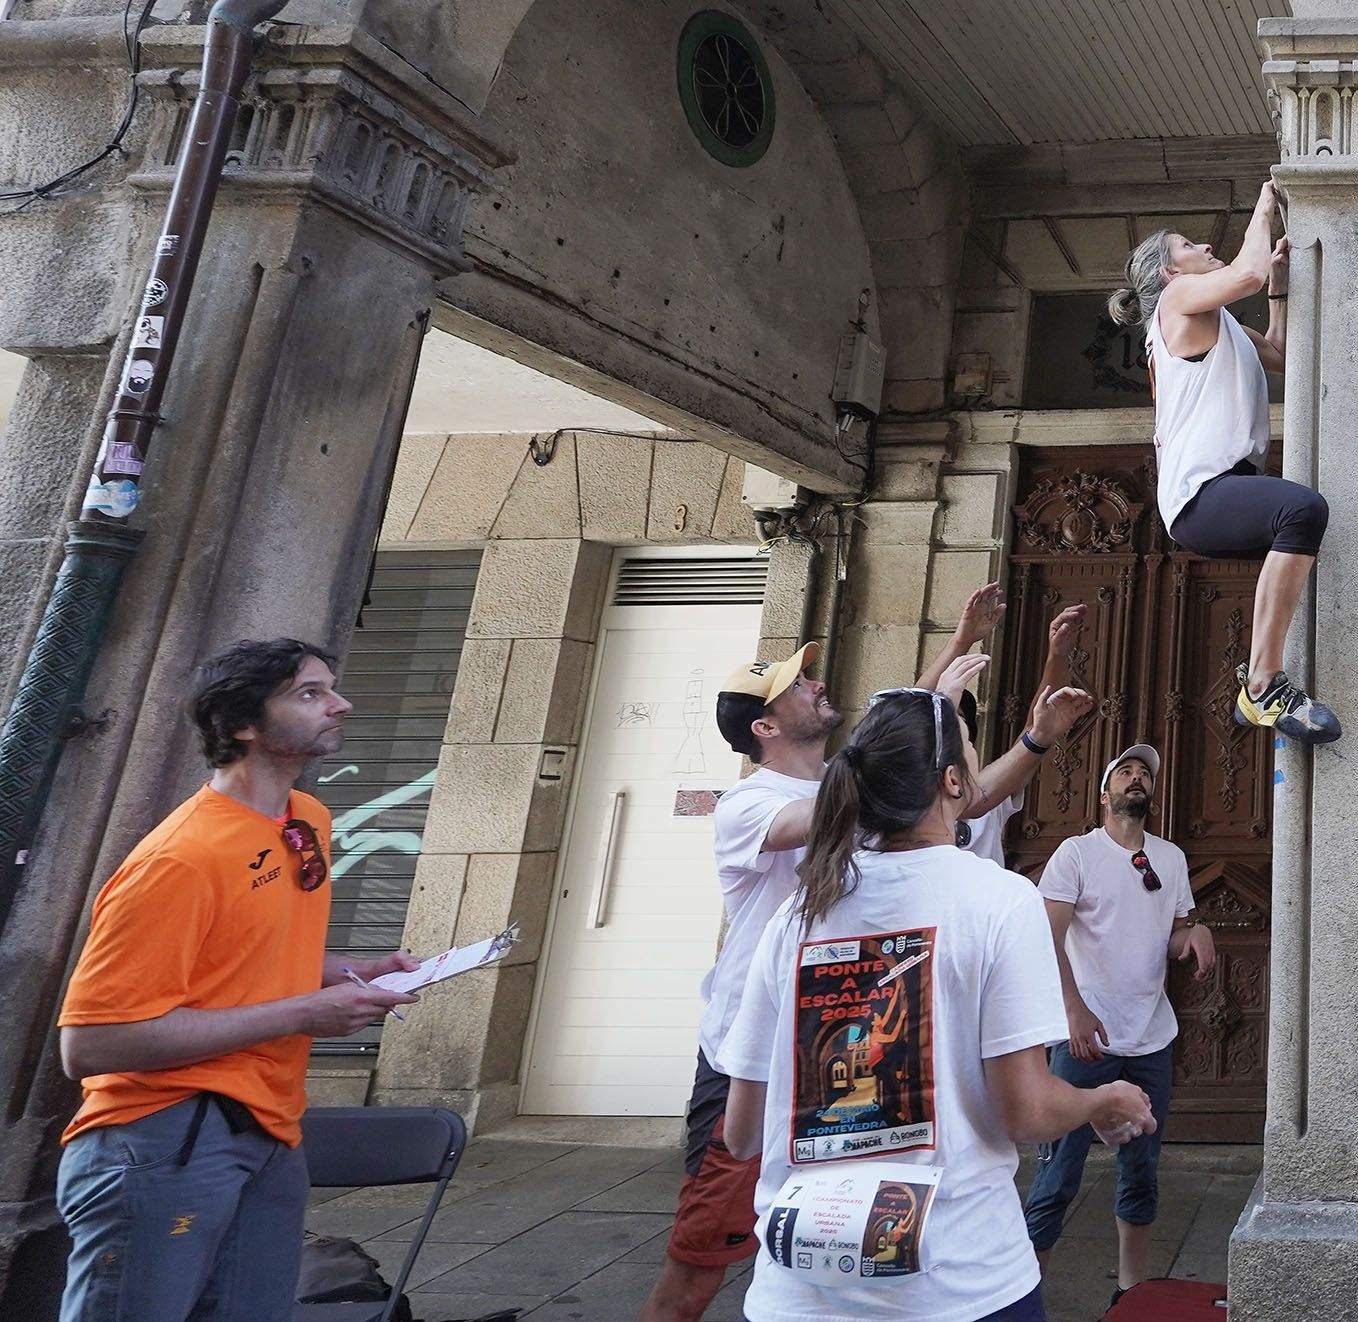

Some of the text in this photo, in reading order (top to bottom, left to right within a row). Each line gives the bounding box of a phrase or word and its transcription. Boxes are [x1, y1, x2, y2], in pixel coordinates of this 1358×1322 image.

[671, 504, 688, 532] 3
[814, 960, 884, 978] PONTE
[840, 978, 857, 990] A
[800, 987, 895, 1008] ESCALAR
[820, 1004, 872, 1021] 2025
[840, 1115, 857, 1124] EN
[806, 1120, 888, 1136] PONTEVEDRA
[901, 1128, 929, 1139] BONOBO
[788, 1186, 803, 1200] 7
[774, 1208, 790, 1266] DORSAL
